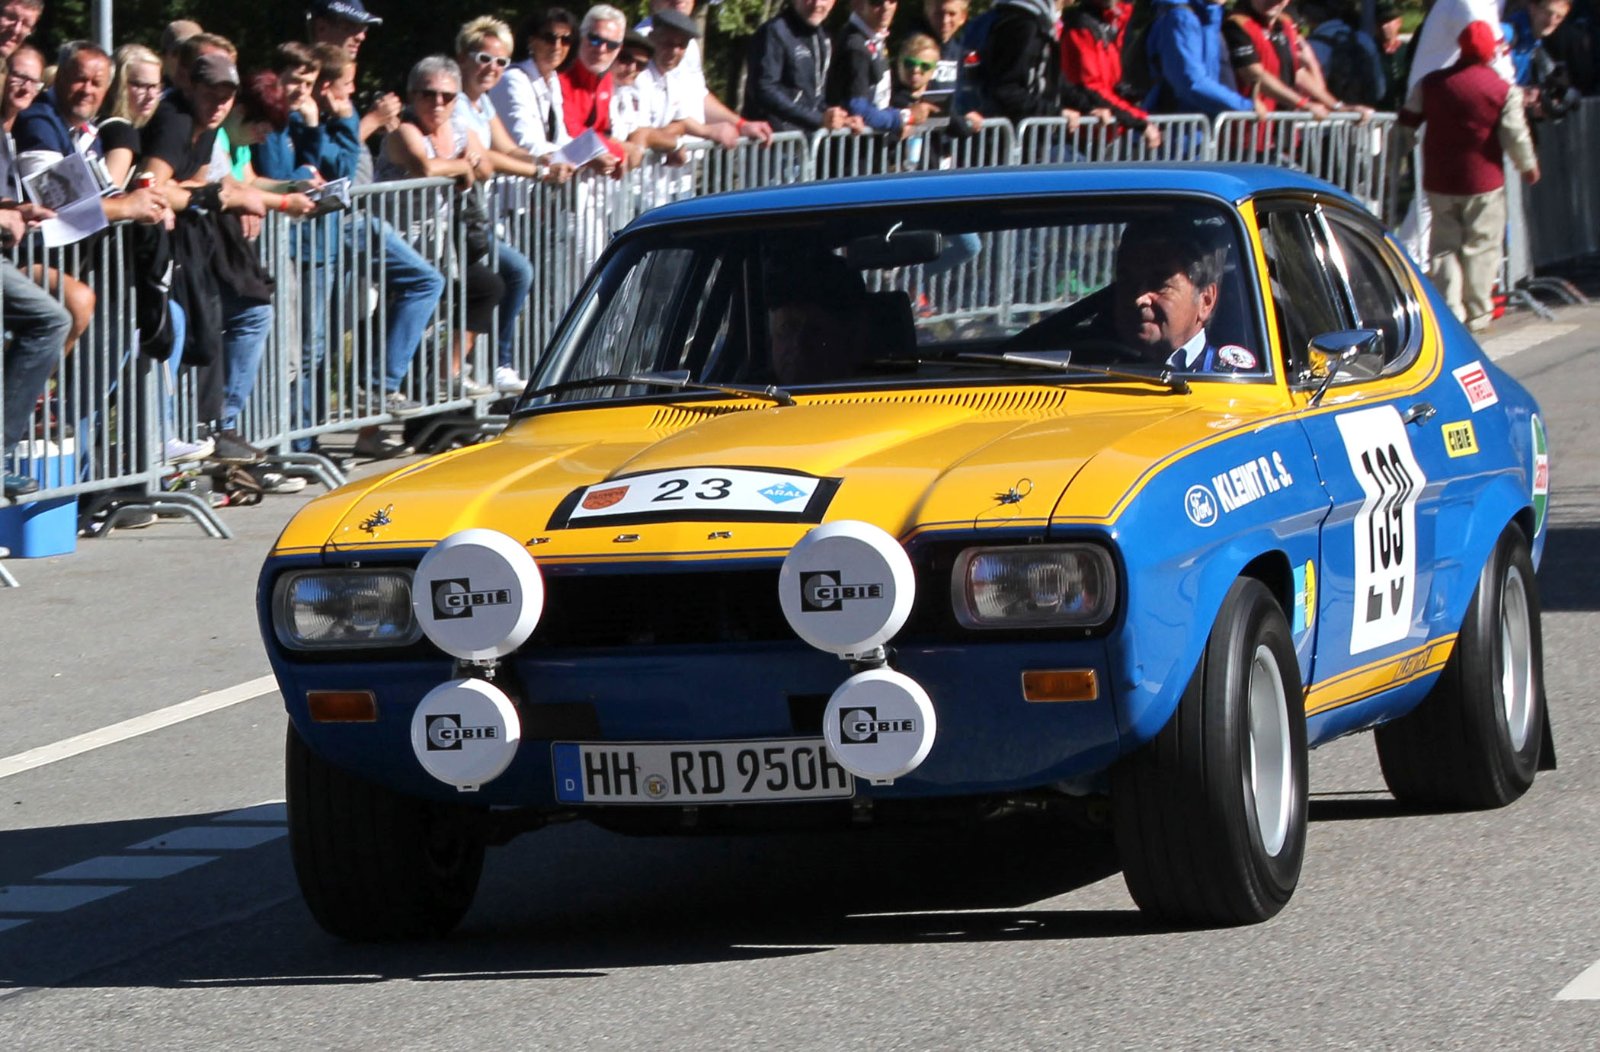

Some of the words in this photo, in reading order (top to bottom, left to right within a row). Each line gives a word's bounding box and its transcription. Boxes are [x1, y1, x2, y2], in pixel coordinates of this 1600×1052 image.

[651, 478, 733, 502] 23
[763, 489, 803, 497] ARAL
[1212, 460, 1266, 513] KLEINT
[584, 752, 638, 795] HH
[670, 751, 726, 794] RD
[737, 746, 847, 793] 950H
[565, 778, 575, 791] D
